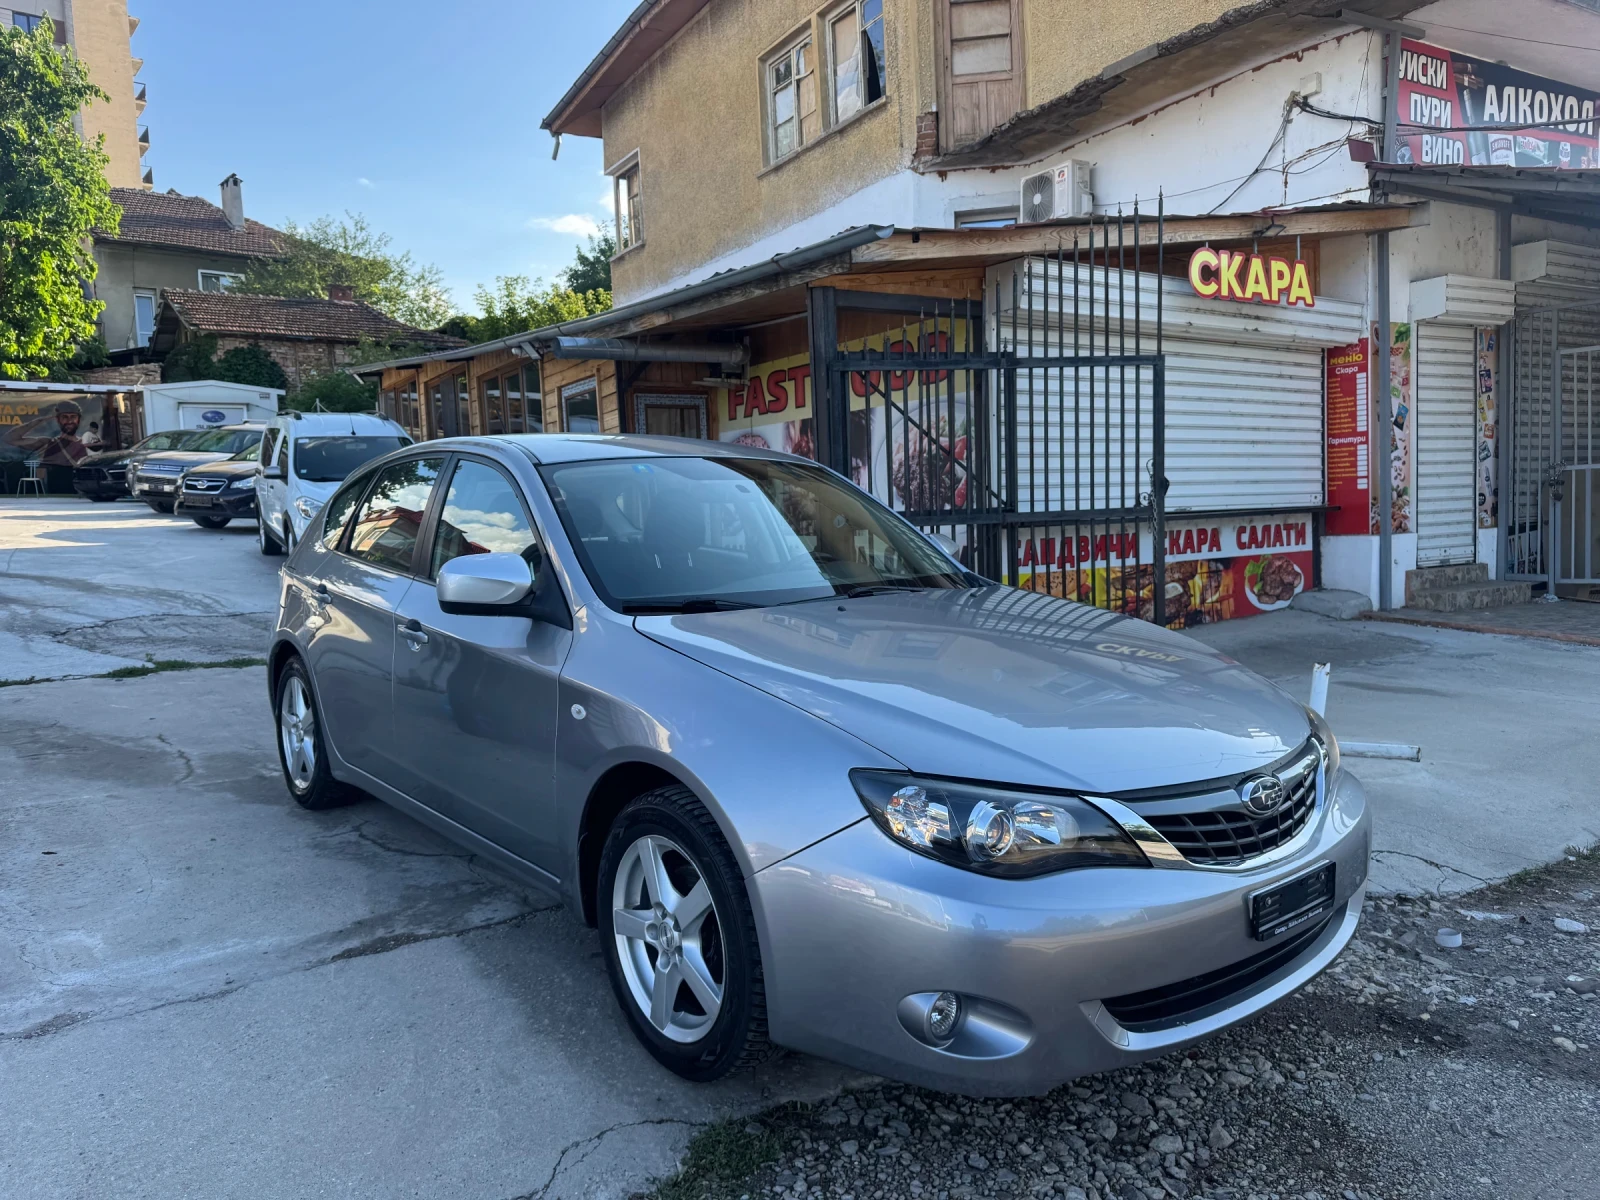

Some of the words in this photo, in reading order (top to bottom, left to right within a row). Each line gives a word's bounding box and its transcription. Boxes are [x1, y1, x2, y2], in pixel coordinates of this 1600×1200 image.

[1399, 50, 1447, 90] УИСКИ
[1410, 92, 1452, 129] ПУРИ
[1483, 84, 1594, 136] АЛКОХОЛ
[1421, 134, 1464, 165] ВИНО
[1189, 247, 1315, 307] СКАРА
[728, 363, 811, 421] FAST
[850, 330, 948, 398] OOD
[1335, 366, 1358, 375] Скара
[1328, 436, 1366, 445] Гарнитури
[1017, 532, 1137, 570] АНДВИЧИ
[1164, 527, 1222, 556] КАРА
[1236, 522, 1306, 551] САЛАТИ
